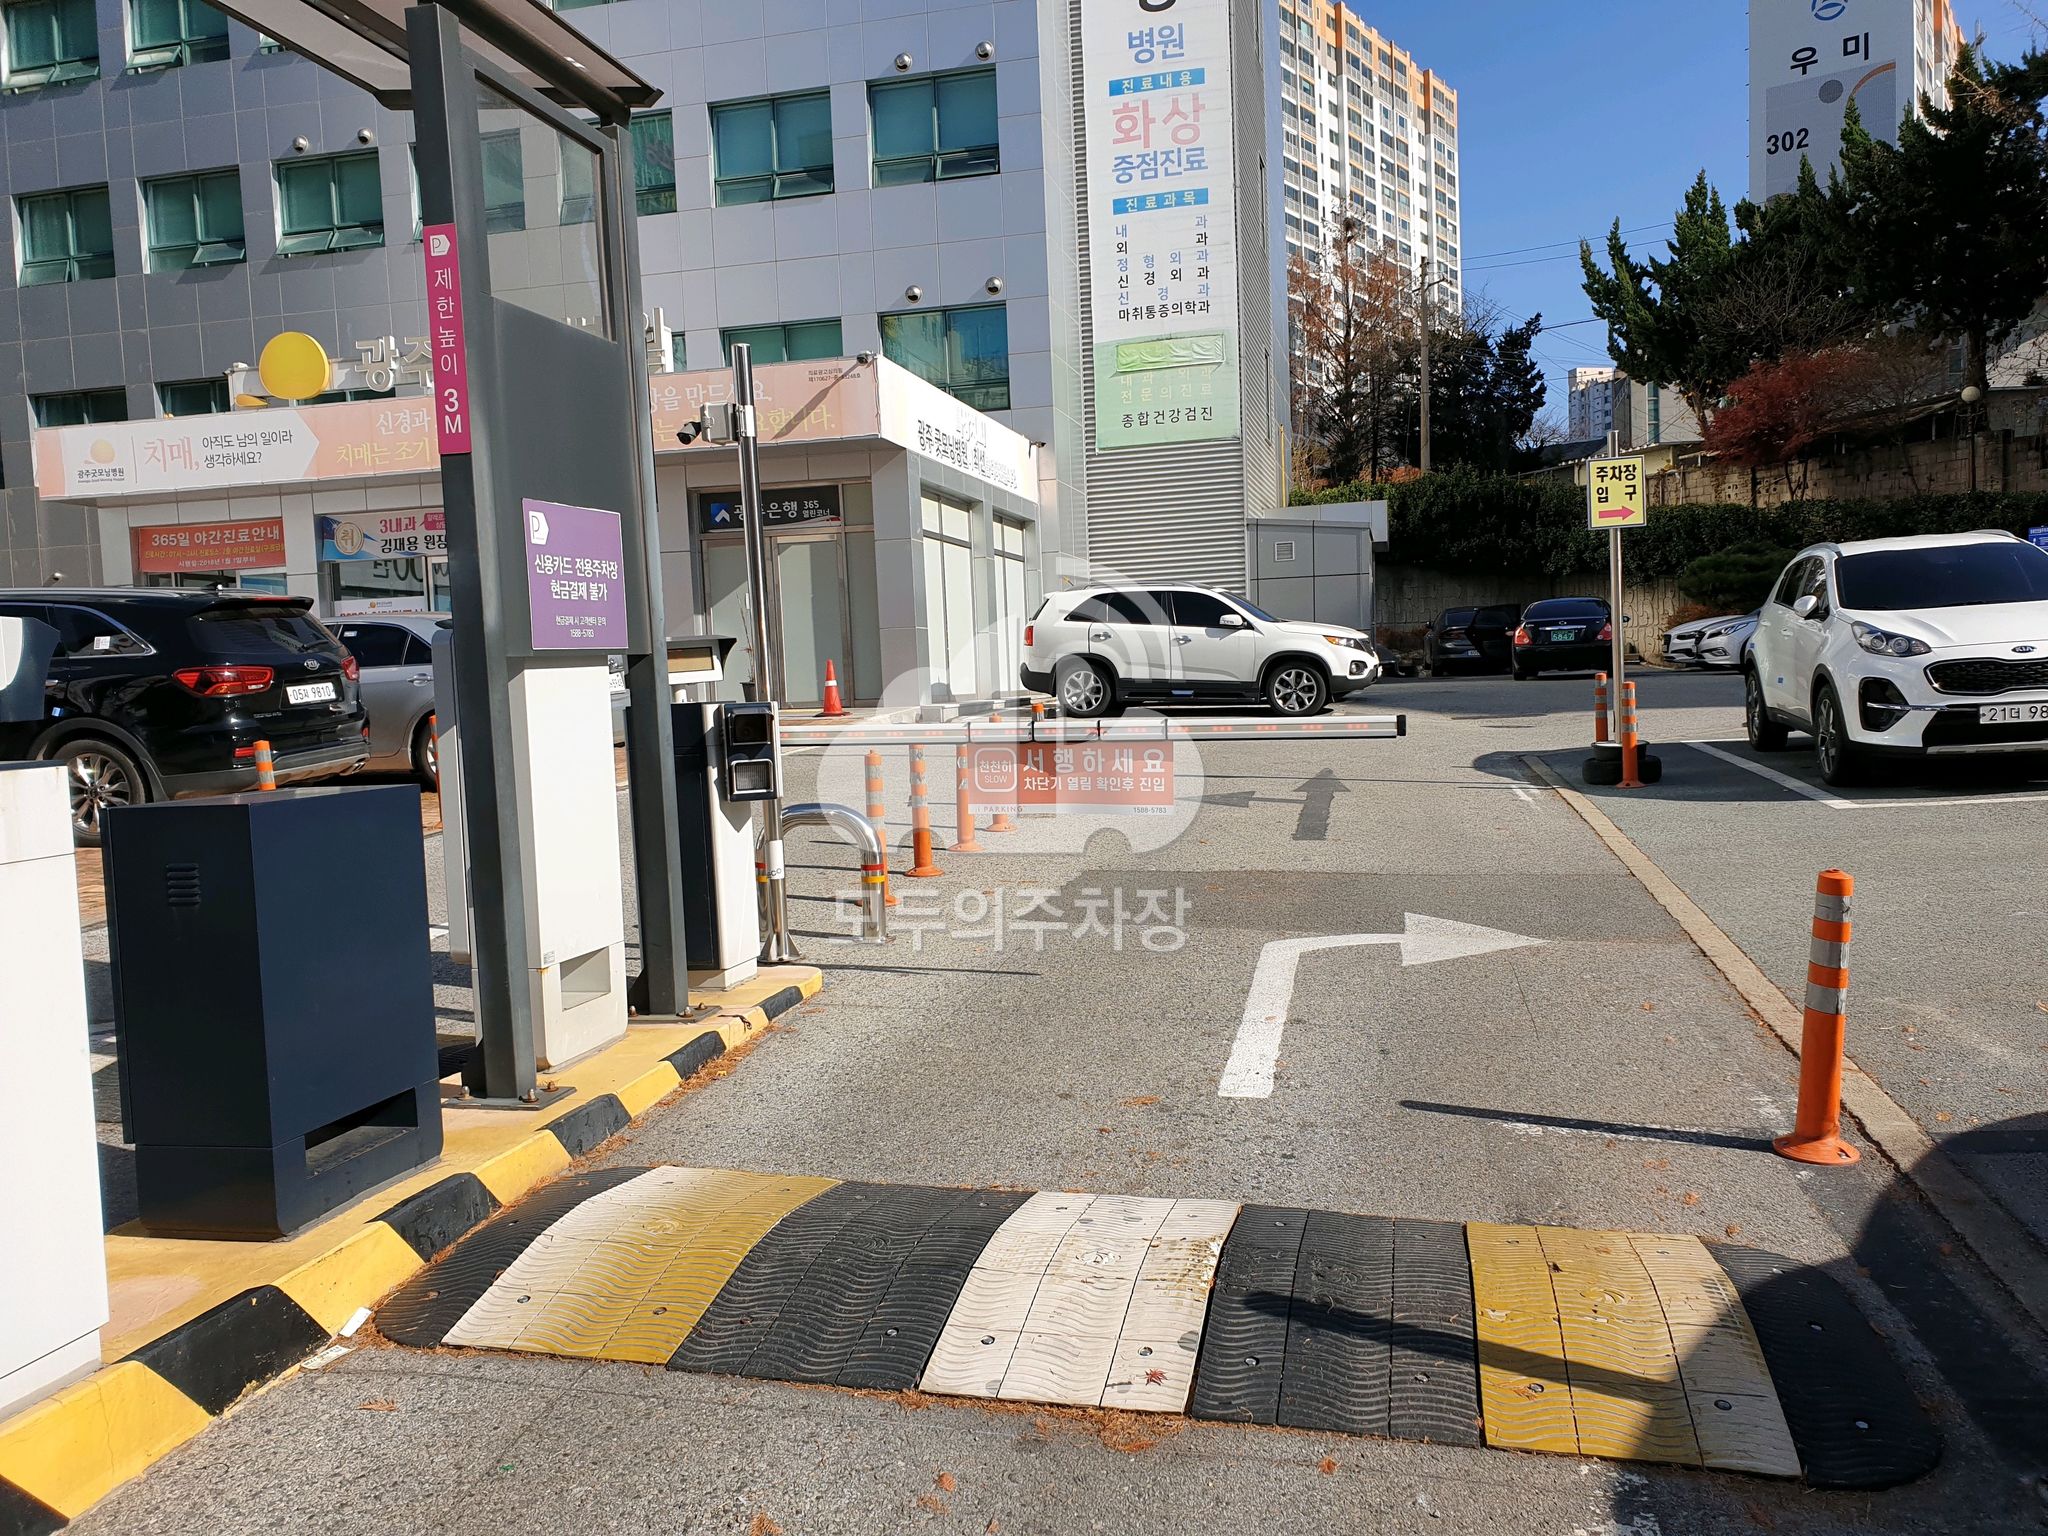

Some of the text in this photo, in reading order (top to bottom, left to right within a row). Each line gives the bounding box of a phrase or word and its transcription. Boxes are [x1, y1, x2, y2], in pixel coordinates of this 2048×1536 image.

[1127, 23, 1185, 64] 병원
[1790, 32, 1869, 76] 우미
[1122, 71, 1193, 94] 진료내용
[1112, 93, 1206, 149] 화상
[1766, 128, 1809, 155] 302
[1112, 147, 1208, 184] 중점진료
[1126, 191, 1197, 212] 진료과목
[434, 267, 459, 376] 제한높이
[1119, 300, 1211, 322] 마취통증의학과
[376, 408, 431, 435] 신경과
[1122, 406, 1213, 429] 종합건강검진
[202, 429, 292, 450] 아직도 남의 일이라
[143, 436, 200, 472] 치매,
[204, 451, 262, 469] 생각하세요?
[336, 437, 431, 467] 치매는 조기
[77, 467, 125, 479] 광주굿모닝병원
[1596, 464, 1637, 483] 주차장
[1596, 484, 1637, 503] 입구
[802, 508, 830, 518] 열린코너
[803, 500, 820, 510] 365
[152, 525, 280, 547] 365일 야간진료안내
[380, 516, 417, 534] 3내과
[381, 535, 419, 554] 김재용
[534, 554, 618, 580] 신용카드 전용주차장
[550, 579, 608, 602] 현금결제 불가
[311, 685, 332, 699] 9810
[979, 760, 1012, 773] 천천히
[1022, 748, 1166, 774] 서행하세요
[984, 775, 1008, 784] SLOW
[1023, 776, 1165, 792] 차단기 열림 확인후 진입
[1133, 806, 1168, 815] 1588-5783
